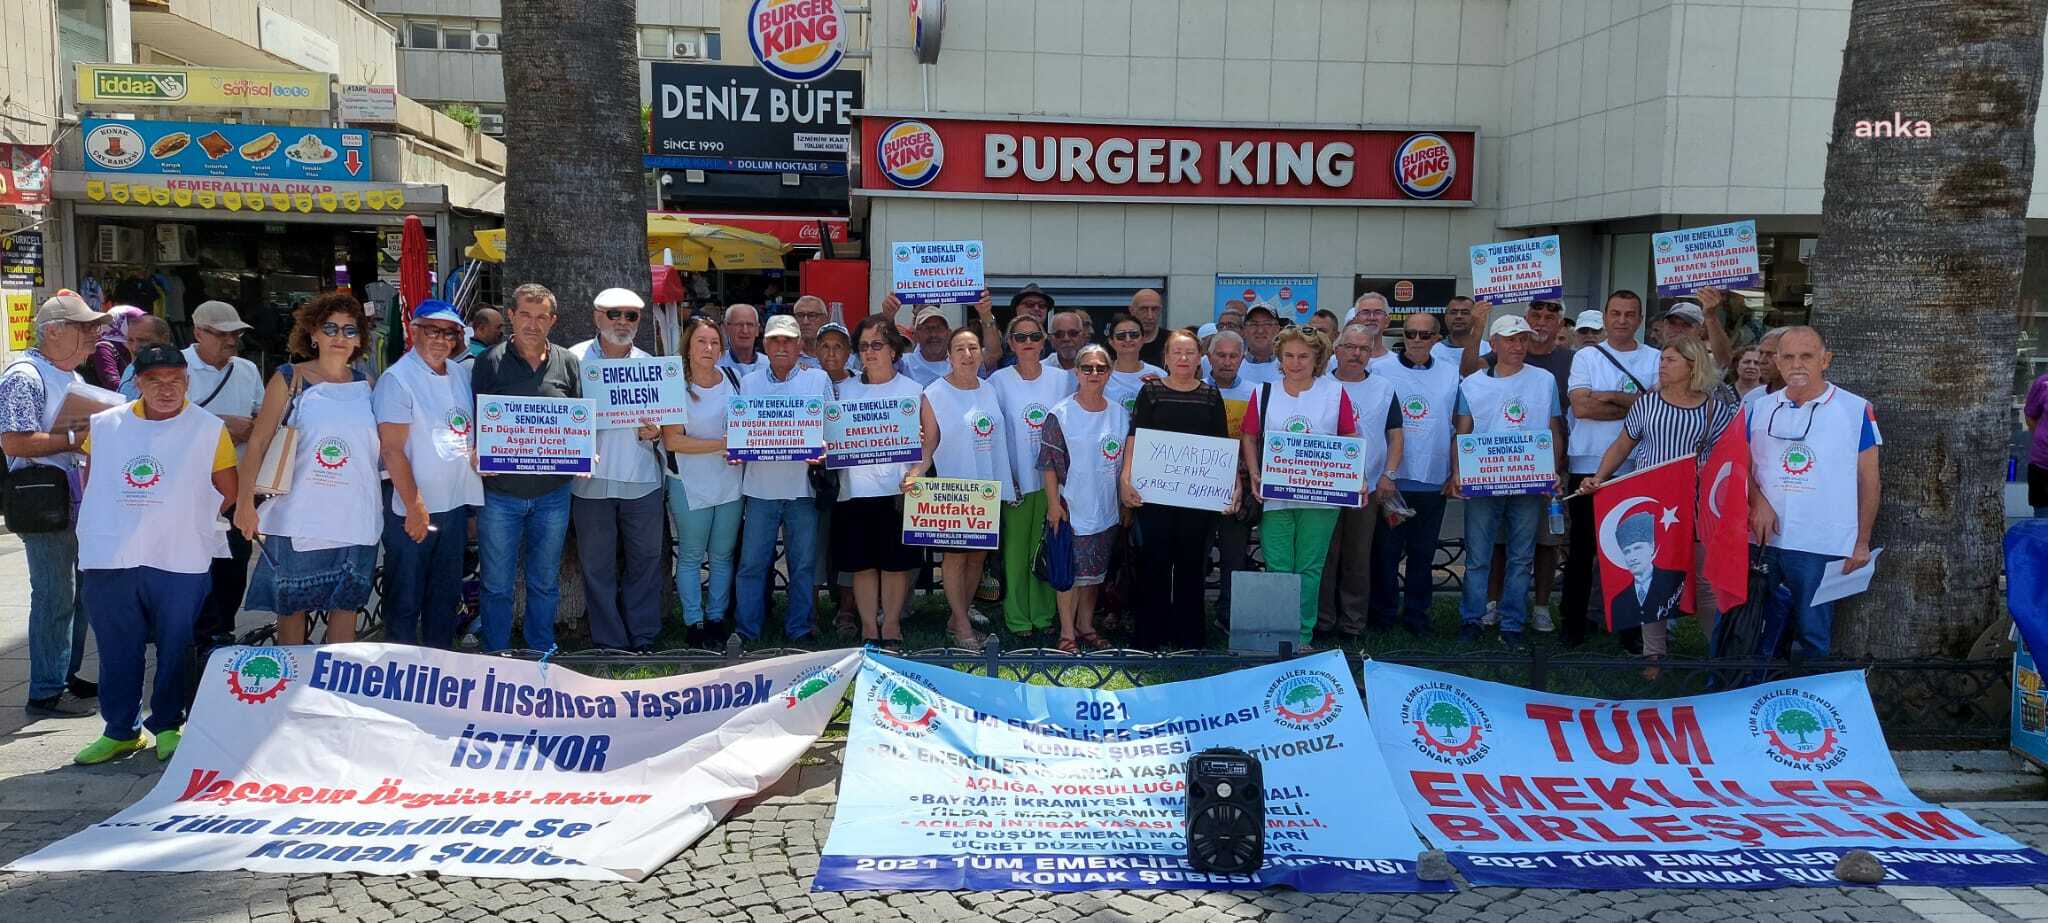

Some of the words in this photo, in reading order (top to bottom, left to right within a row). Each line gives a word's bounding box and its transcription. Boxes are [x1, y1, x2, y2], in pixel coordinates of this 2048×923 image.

[759, 0, 833, 32] BURGER
[763, 15, 837, 57] KING
[100, 76, 156, 93] iddaa
[661, 79, 760, 122] DENİZ
[771, 84, 852, 125] BÜFE
[100, 128, 128, 136] KONAK
[699, 142, 724, 151] 1990
[884, 133, 931, 155] BURGER
[738, 160, 773, 169] DOLUM
[775, 162, 817, 170] NOKTASI
[887, 143, 934, 171] KING
[984, 134, 1201, 184] BURGER
[1218, 141, 1354, 187] KING
[1402, 146, 1447, 168] BURGER
[1403, 156, 1449, 184] KING
[167, 180, 280, 193] KEMERALTI'NA
[1674, 233, 1689, 242] TÜM
[1692, 228, 1734, 241] EMEKLİLER
[912, 245, 926, 253] TÜM
[928, 243, 964, 253] EMEKLİLER
[1504, 242, 1540, 253] EMEKLİLER
[1685, 240, 1724, 252] SENDİKASI
[921, 255, 955, 263] SENDİKASI
[914, 267, 964, 276] EMEKLİYİZ
[897, 280, 934, 289] DİLENCİ
[15, 330, 31, 340] WC
[602, 363, 663, 384] EMEKLİLER
[610, 384, 659, 408] BİRLEŞİN
[749, 398, 763, 408] TÜM
[766, 397, 804, 408] EMEKLİLER
[505, 401, 521, 412] TÜM
[524, 402, 568, 414] EMEKLİLER
[842, 403, 858, 412] TÜM
[860, 398, 898, 411] EMEKLİLER
[516, 414, 557, 424] SENDİKASI
[758, 409, 794, 418] SENDİKASI
[853, 412, 889, 422] SENDİKASI
[497, 425, 525, 434] Düşük
[529, 426, 560, 434] Emekli
[564, 427, 590, 437] Maaşı
[846, 424, 899, 436] EMEKLİYİZ
[507, 436, 537, 445] Asgari
[540, 436, 566, 445] Ücret
[828, 439, 867, 450] DİLENCİ
[1287, 438, 1302, 446] TÜM
[1304, 439, 1342, 450] EMEKLİLER
[1295, 449, 1331, 460] SENDİKASI
[1488, 446, 1524, 454] SENDİKASI
[1274, 456, 1352, 469] Geçinemiyoruz
[1311, 468, 1358, 480] Yaşamak
[925, 482, 939, 491] TÜM
[942, 482, 979, 492] EMEKLİLER
[933, 492, 969, 502] SENDİKASI
[918, 502, 985, 515] Mutfakta
[911, 515, 960, 532] Yangın
[967, 517, 992, 529] Var
[309, 650, 476, 710] Emekliler
[482, 668, 617, 718] İnsanca
[621, 673, 773, 721] Yaşamak
[1400, 704, 1409, 726] TÜM
[1405, 681, 1452, 703] EMEKLİLER
[1455, 688, 1492, 732] SENDİKASI
[1751, 688, 1799, 716] EMEKLİLER
[1075, 701, 1130, 721] 2021
[1274, 719, 1310, 731] KONAK
[1314, 705, 1343, 729] ŞUBESİ
[1802, 691, 1847, 734] SENDİKASI
[1139, 706, 1260, 741] SENDİKASI
[1749, 718, 1760, 737] TÜM
[1526, 702, 1715, 765] TÜM
[450, 724, 610, 772] İSTİYOR
[1107, 737, 1191, 762] ŞUBESİ
[1412, 738, 1452, 764] KONAK
[1456, 743, 1490, 766] ŞUBESİ
[1766, 749, 1812, 771] KONAK
[1815, 746, 1848, 772] ŞUBESİ
[176, 768, 358, 806] Yaşasın
[966, 777, 1044, 795] AÇLIĞA,
[1051, 779, 1185, 795] YOKSULLUĞA
[1409, 766, 1893, 811] EMEKLİLER
[922, 793, 1006, 806] BAYRAM
[1015, 793, 1135, 808] İKRAMİYESİ
[1143, 797, 1151, 807] 1
[152, 815, 272, 835] Tüm
[269, 815, 521, 837] Emekliler
[1001, 818, 1087, 828] İNTİBAK
[1097, 820, 1172, 828] YASASI
[1427, 805, 1984, 847] BİRLEŞELİM
[975, 829, 1050, 840] DÜŞÜK
[1061, 829, 1141, 839] EMEKLİ
[246, 840, 431, 862] Konak
[1042, 840, 1162, 850] DÜZEYİNDE
[855, 858, 937, 872] 2021
[952, 856, 1022, 870] TÜM
[1036, 857, 1189, 871] EMEKLİLE
[1467, 855, 1557, 869] 2021
[1563, 852, 1646, 867] TÜM
[1650, 850, 1841, 867] EMEKLİLER
[1869, 849, 2036, 864] ENDİKASI
[1011, 870, 1124, 885] KONAK
[1139, 870, 1261, 886] ŞUBESİ
[1644, 868, 1775, 884] KONAK
